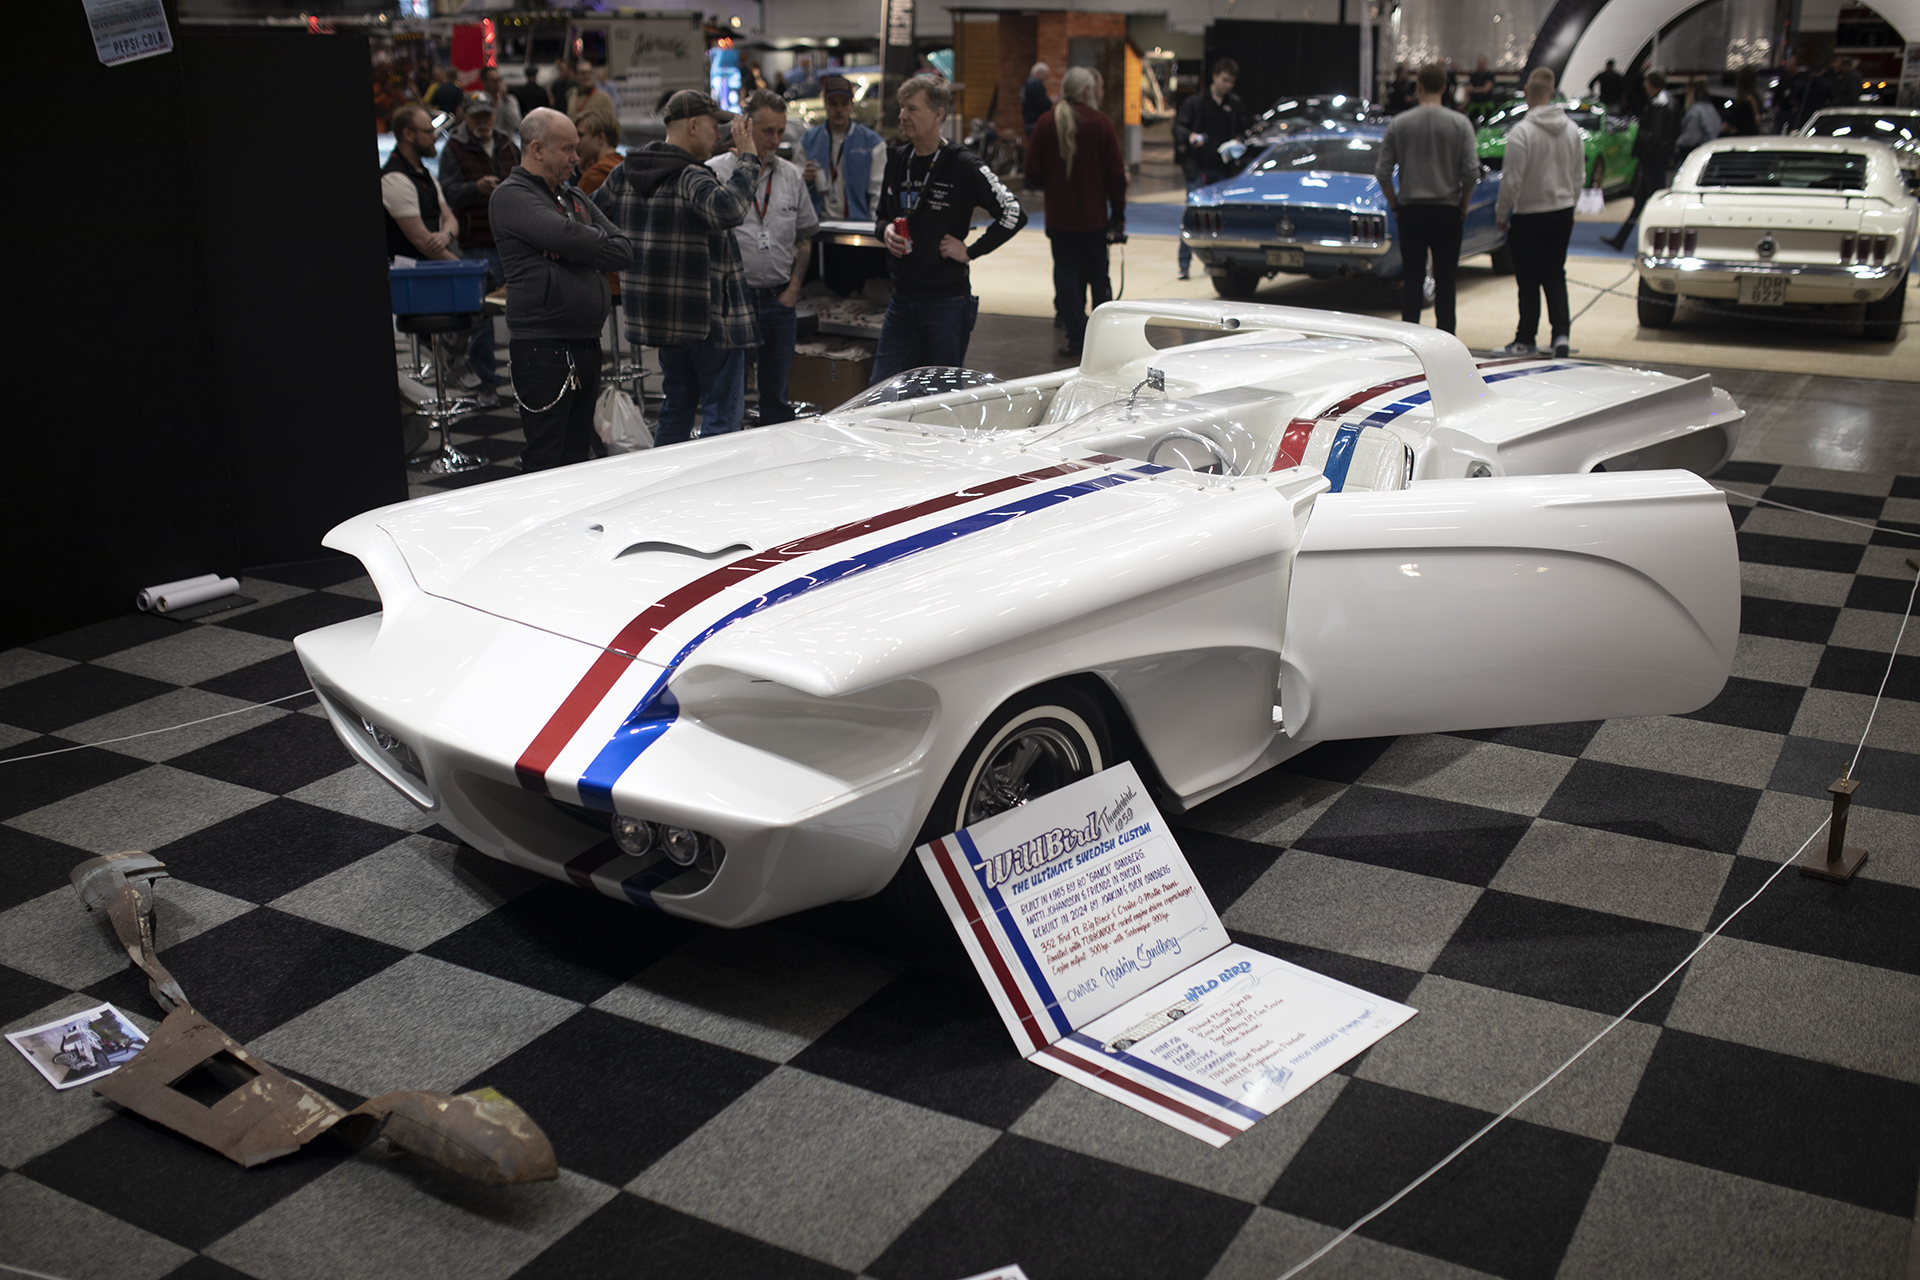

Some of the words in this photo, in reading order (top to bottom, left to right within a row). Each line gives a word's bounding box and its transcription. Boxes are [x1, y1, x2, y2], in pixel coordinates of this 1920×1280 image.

[112, 31, 165, 55] PEPSI-COLA
[1114, 807, 1134, 834] 1959
[1011, 878, 1030, 896] THE
[1118, 822, 1152, 846] CUSTOM
[1020, 897, 1040, 916] BUILT
[1037, 893, 1049, 906] IN
[1048, 886, 1066, 901] 1965
[1065, 881, 1076, 894] BY
[1076, 876, 1087, 889] BO
[1113, 848, 1145, 871] SANDBERG
[1025, 909, 1046, 926] MATTI
[1047, 892, 1081, 917] JOHANSSON
[1086, 878, 1112, 897] FRIENDS
[1111, 874, 1120, 886] IN
[1119, 863, 1142, 882] SWEDEN
[1032, 917, 1059, 939] REBUILT
[1060, 913, 1069, 925] IN
[1069, 904, 1088, 921] 2024
[1089, 898, 1099, 912] BY
[1101, 887, 1124, 905] JOAKIM
[1127, 877, 1144, 893] SVEN
[1144, 864, 1171, 884] SANDBERG
[1040, 938, 1057, 954] 352
[1082, 920, 1095, 933] Big
[1051, 962, 1070, 976] Engine
[1112, 932, 1125, 945] with
[1068, 941, 1082, 954] with
[1132, 908, 1148, 921] engine
[1067, 978, 1100, 1002] OWNER
[1100, 956, 1140, 989] Joakim
[1136, 936, 1181, 969] Sandberg
